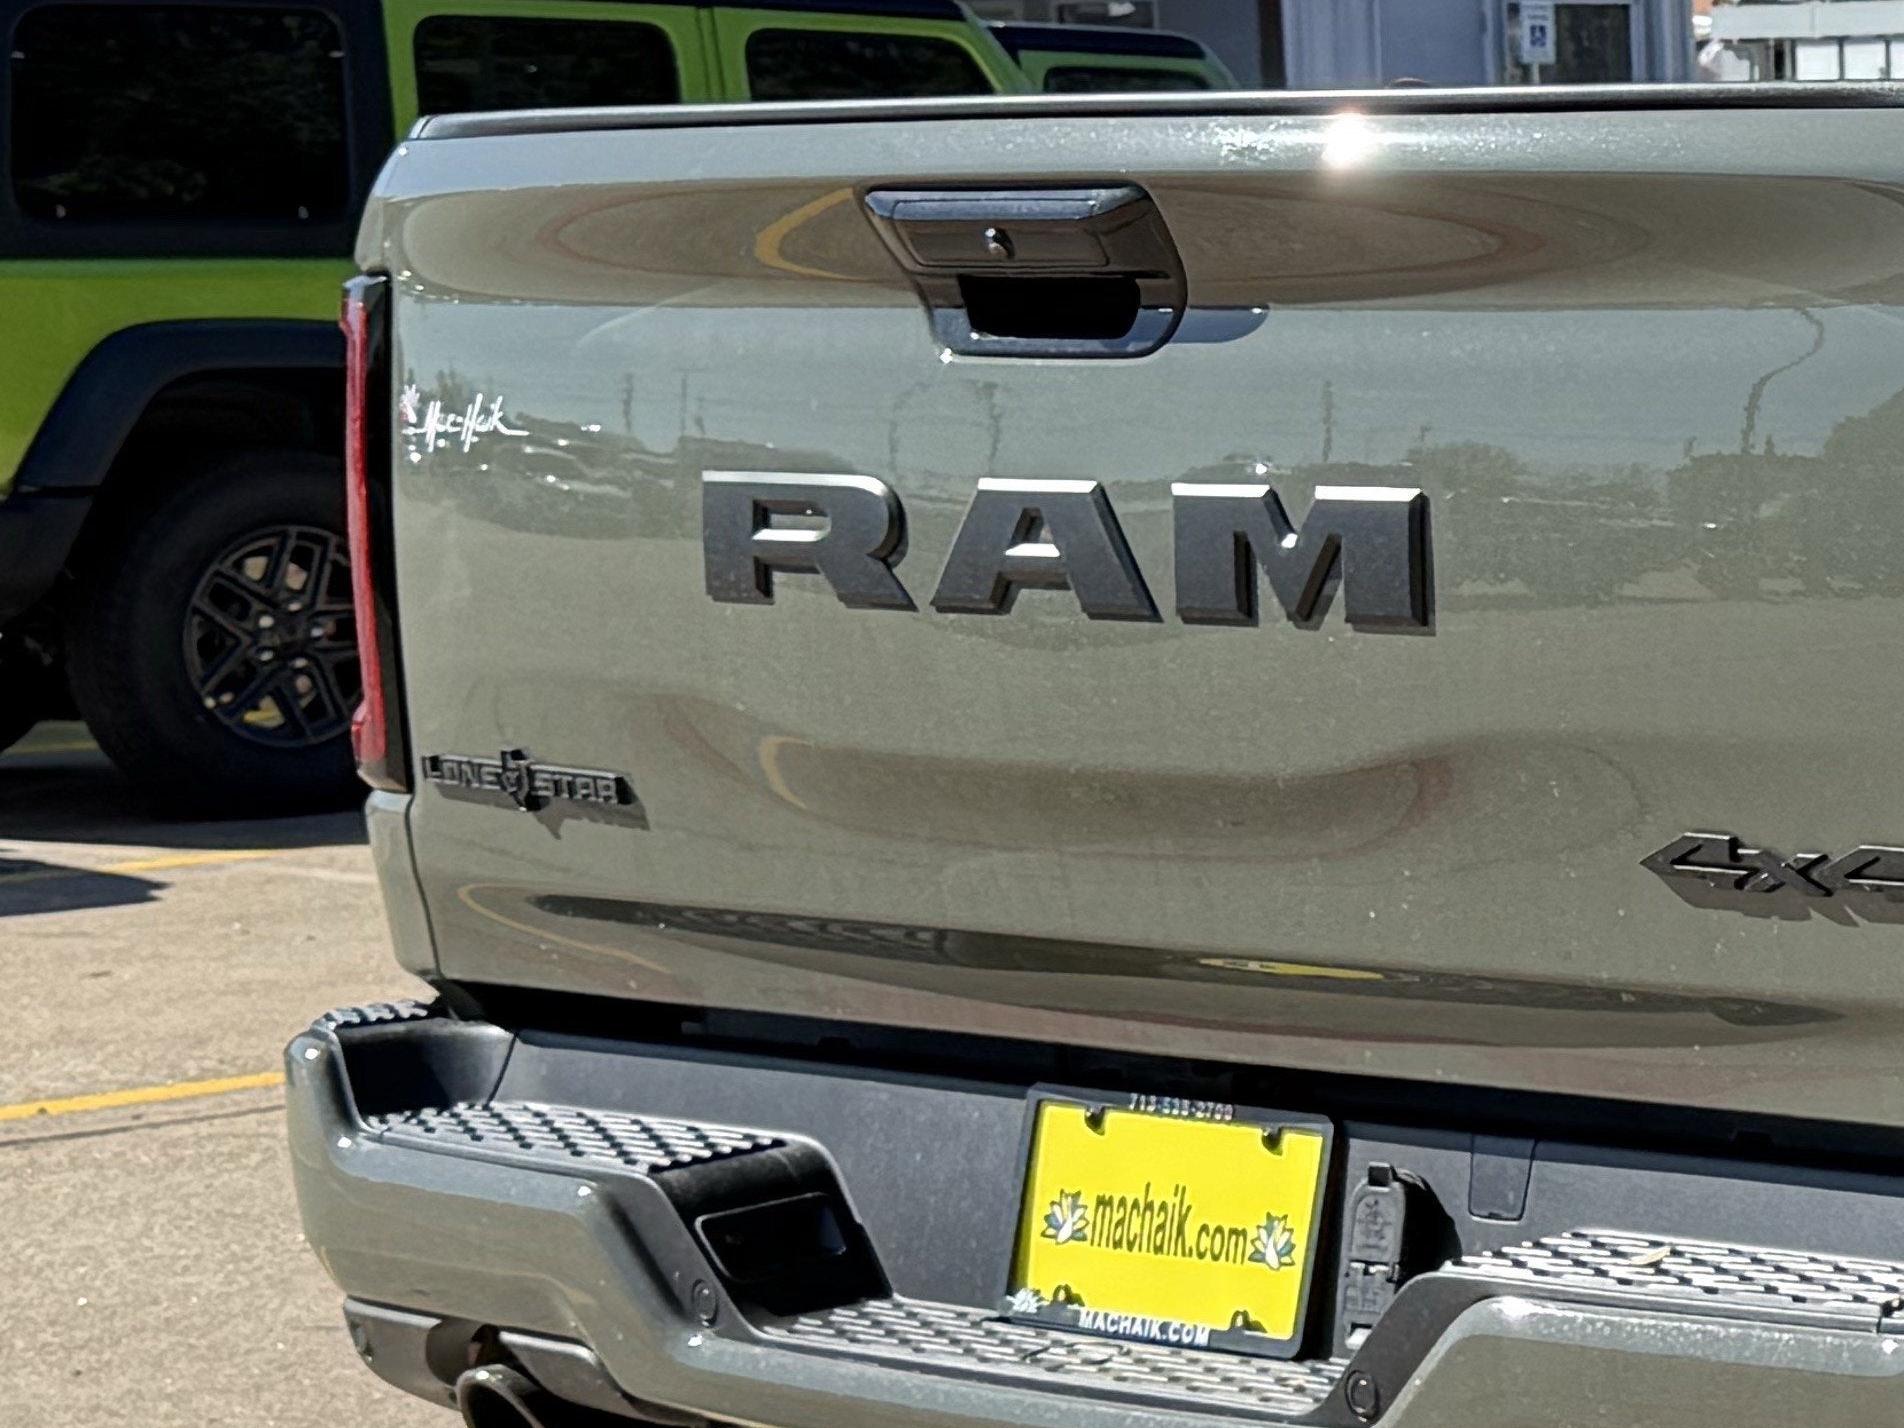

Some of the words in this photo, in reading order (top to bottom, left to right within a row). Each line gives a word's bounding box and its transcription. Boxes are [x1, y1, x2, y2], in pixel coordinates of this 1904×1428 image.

[702, 469, 1436, 636] RAM
[422, 755, 502, 789] LONE
[531, 765, 621, 804] STAR
[1090, 1182, 1248, 1265] machaik.com
[1078, 1309, 1211, 1346] MACHAIK.COM
